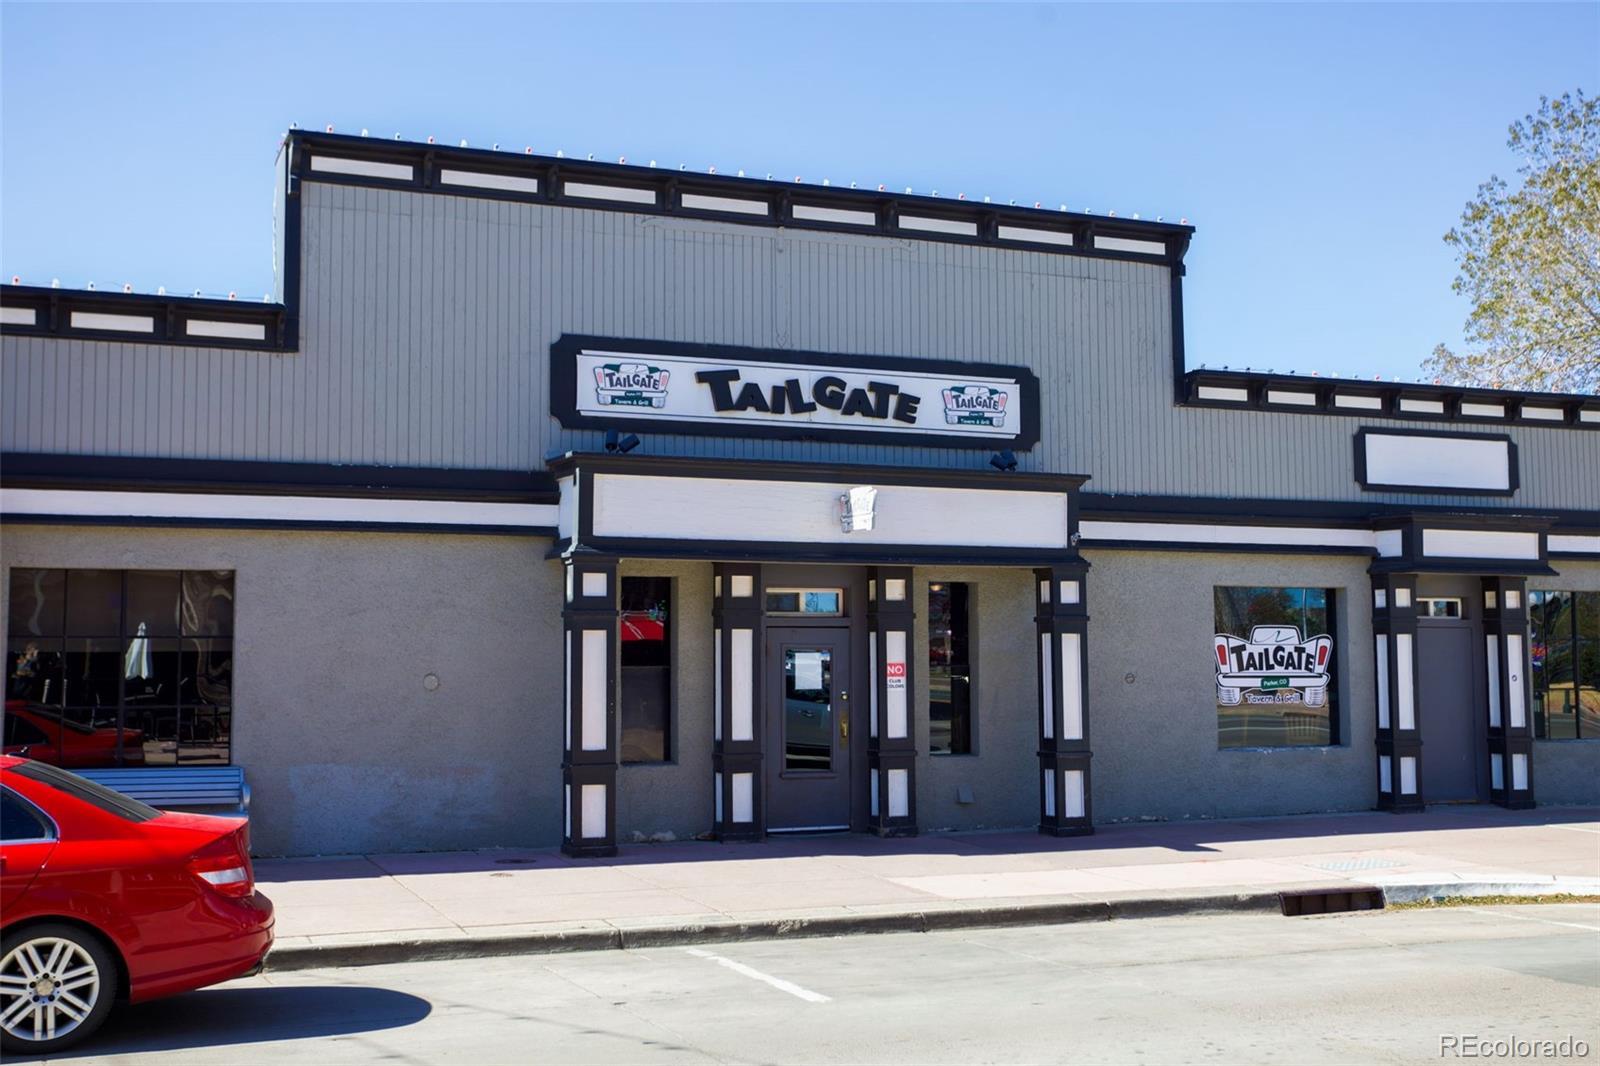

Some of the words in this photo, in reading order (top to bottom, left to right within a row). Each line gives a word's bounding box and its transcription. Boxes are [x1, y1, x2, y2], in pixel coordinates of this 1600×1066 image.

[606, 372, 660, 390] TAILGATE
[695, 369, 921, 424] TAILGATE
[952, 394, 999, 411] TAILGATE
[1230, 644, 1316, 673] TAILGATE
[887, 665, 903, 674] NO
[1245, 693, 1273, 703] Tavern
[1275, 693, 1281, 703] &
